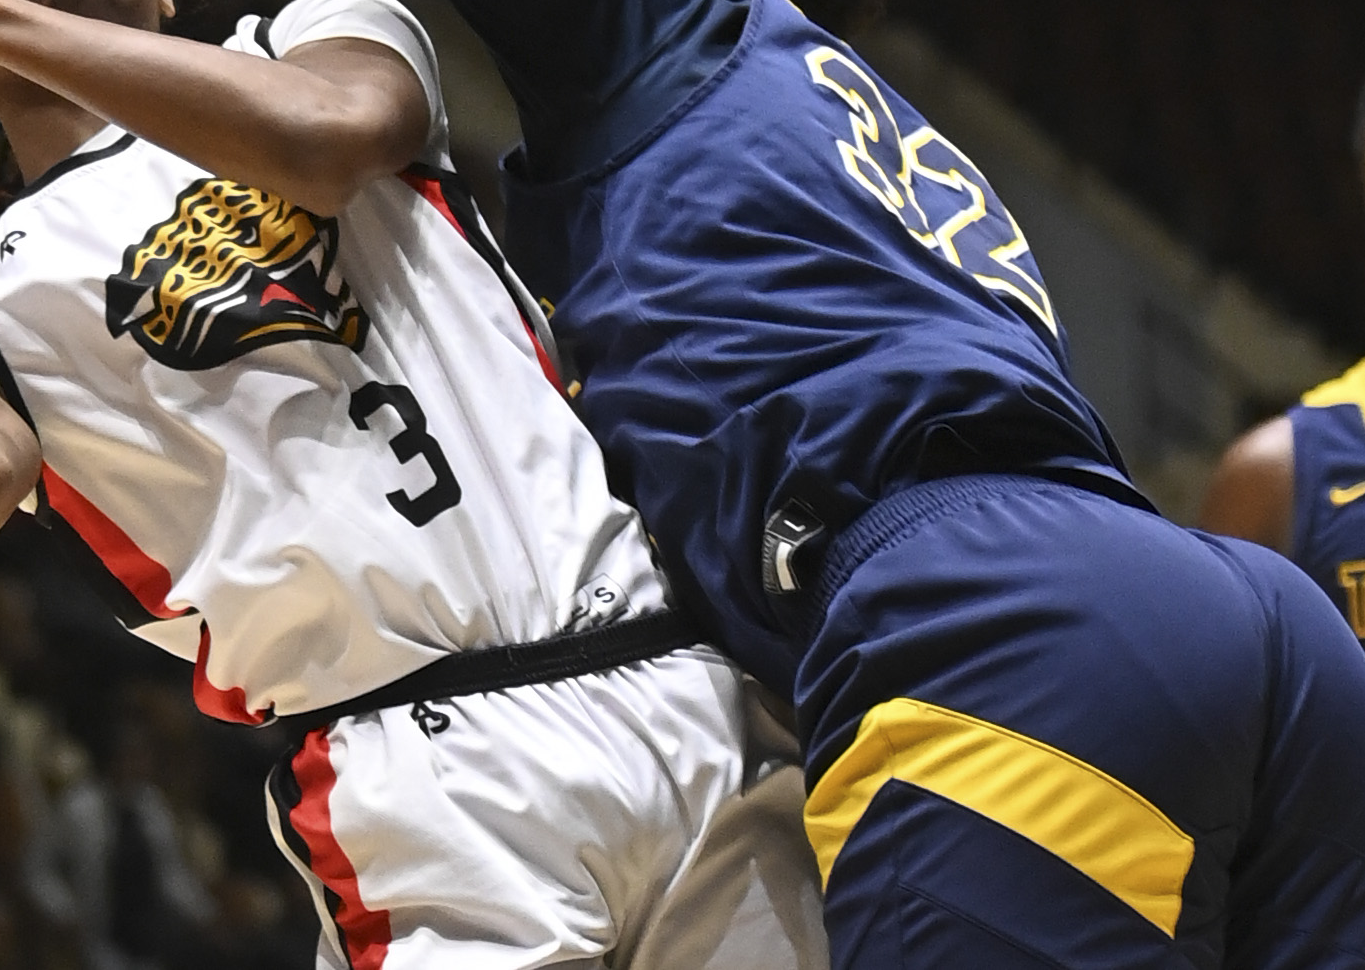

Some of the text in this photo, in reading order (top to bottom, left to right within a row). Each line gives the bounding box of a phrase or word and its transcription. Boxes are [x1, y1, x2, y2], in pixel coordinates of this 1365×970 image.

[805, 46, 1058, 338] 32
[348, 380, 462, 528] 3
[594, 586, 616, 604] S
